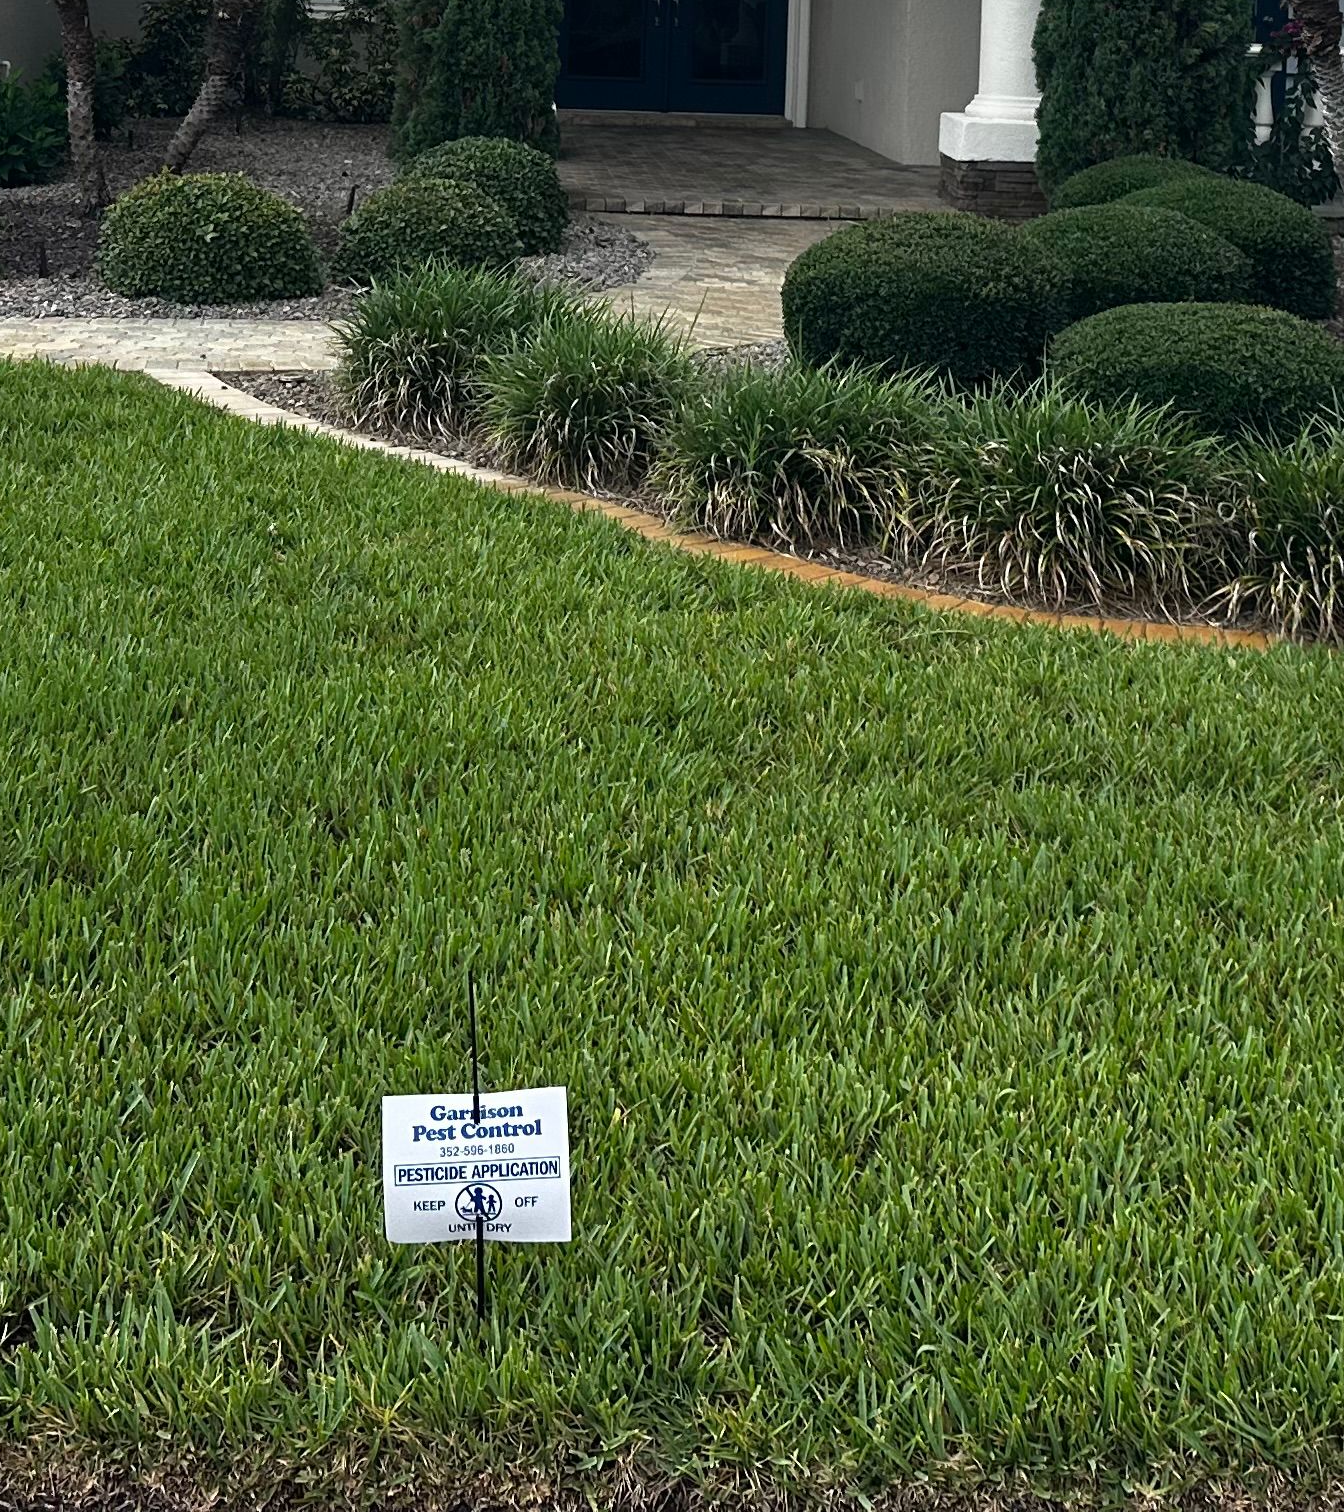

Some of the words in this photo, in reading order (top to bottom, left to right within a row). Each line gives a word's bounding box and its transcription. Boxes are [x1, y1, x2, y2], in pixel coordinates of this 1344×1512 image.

[412, 1124, 456, 1142] Pest
[460, 1119, 542, 1139] Control
[439, 1143, 515, 1158] 352-596-1860
[398, 1165, 467, 1183] PESTICIDE
[471, 1160, 558, 1179] APPLICATION
[413, 1200, 446, 1212] KEEP
[514, 1196, 539, 1208] OFF
[448, 1223, 483, 1233] UNTI
[486, 1223, 513, 1233] DRY
